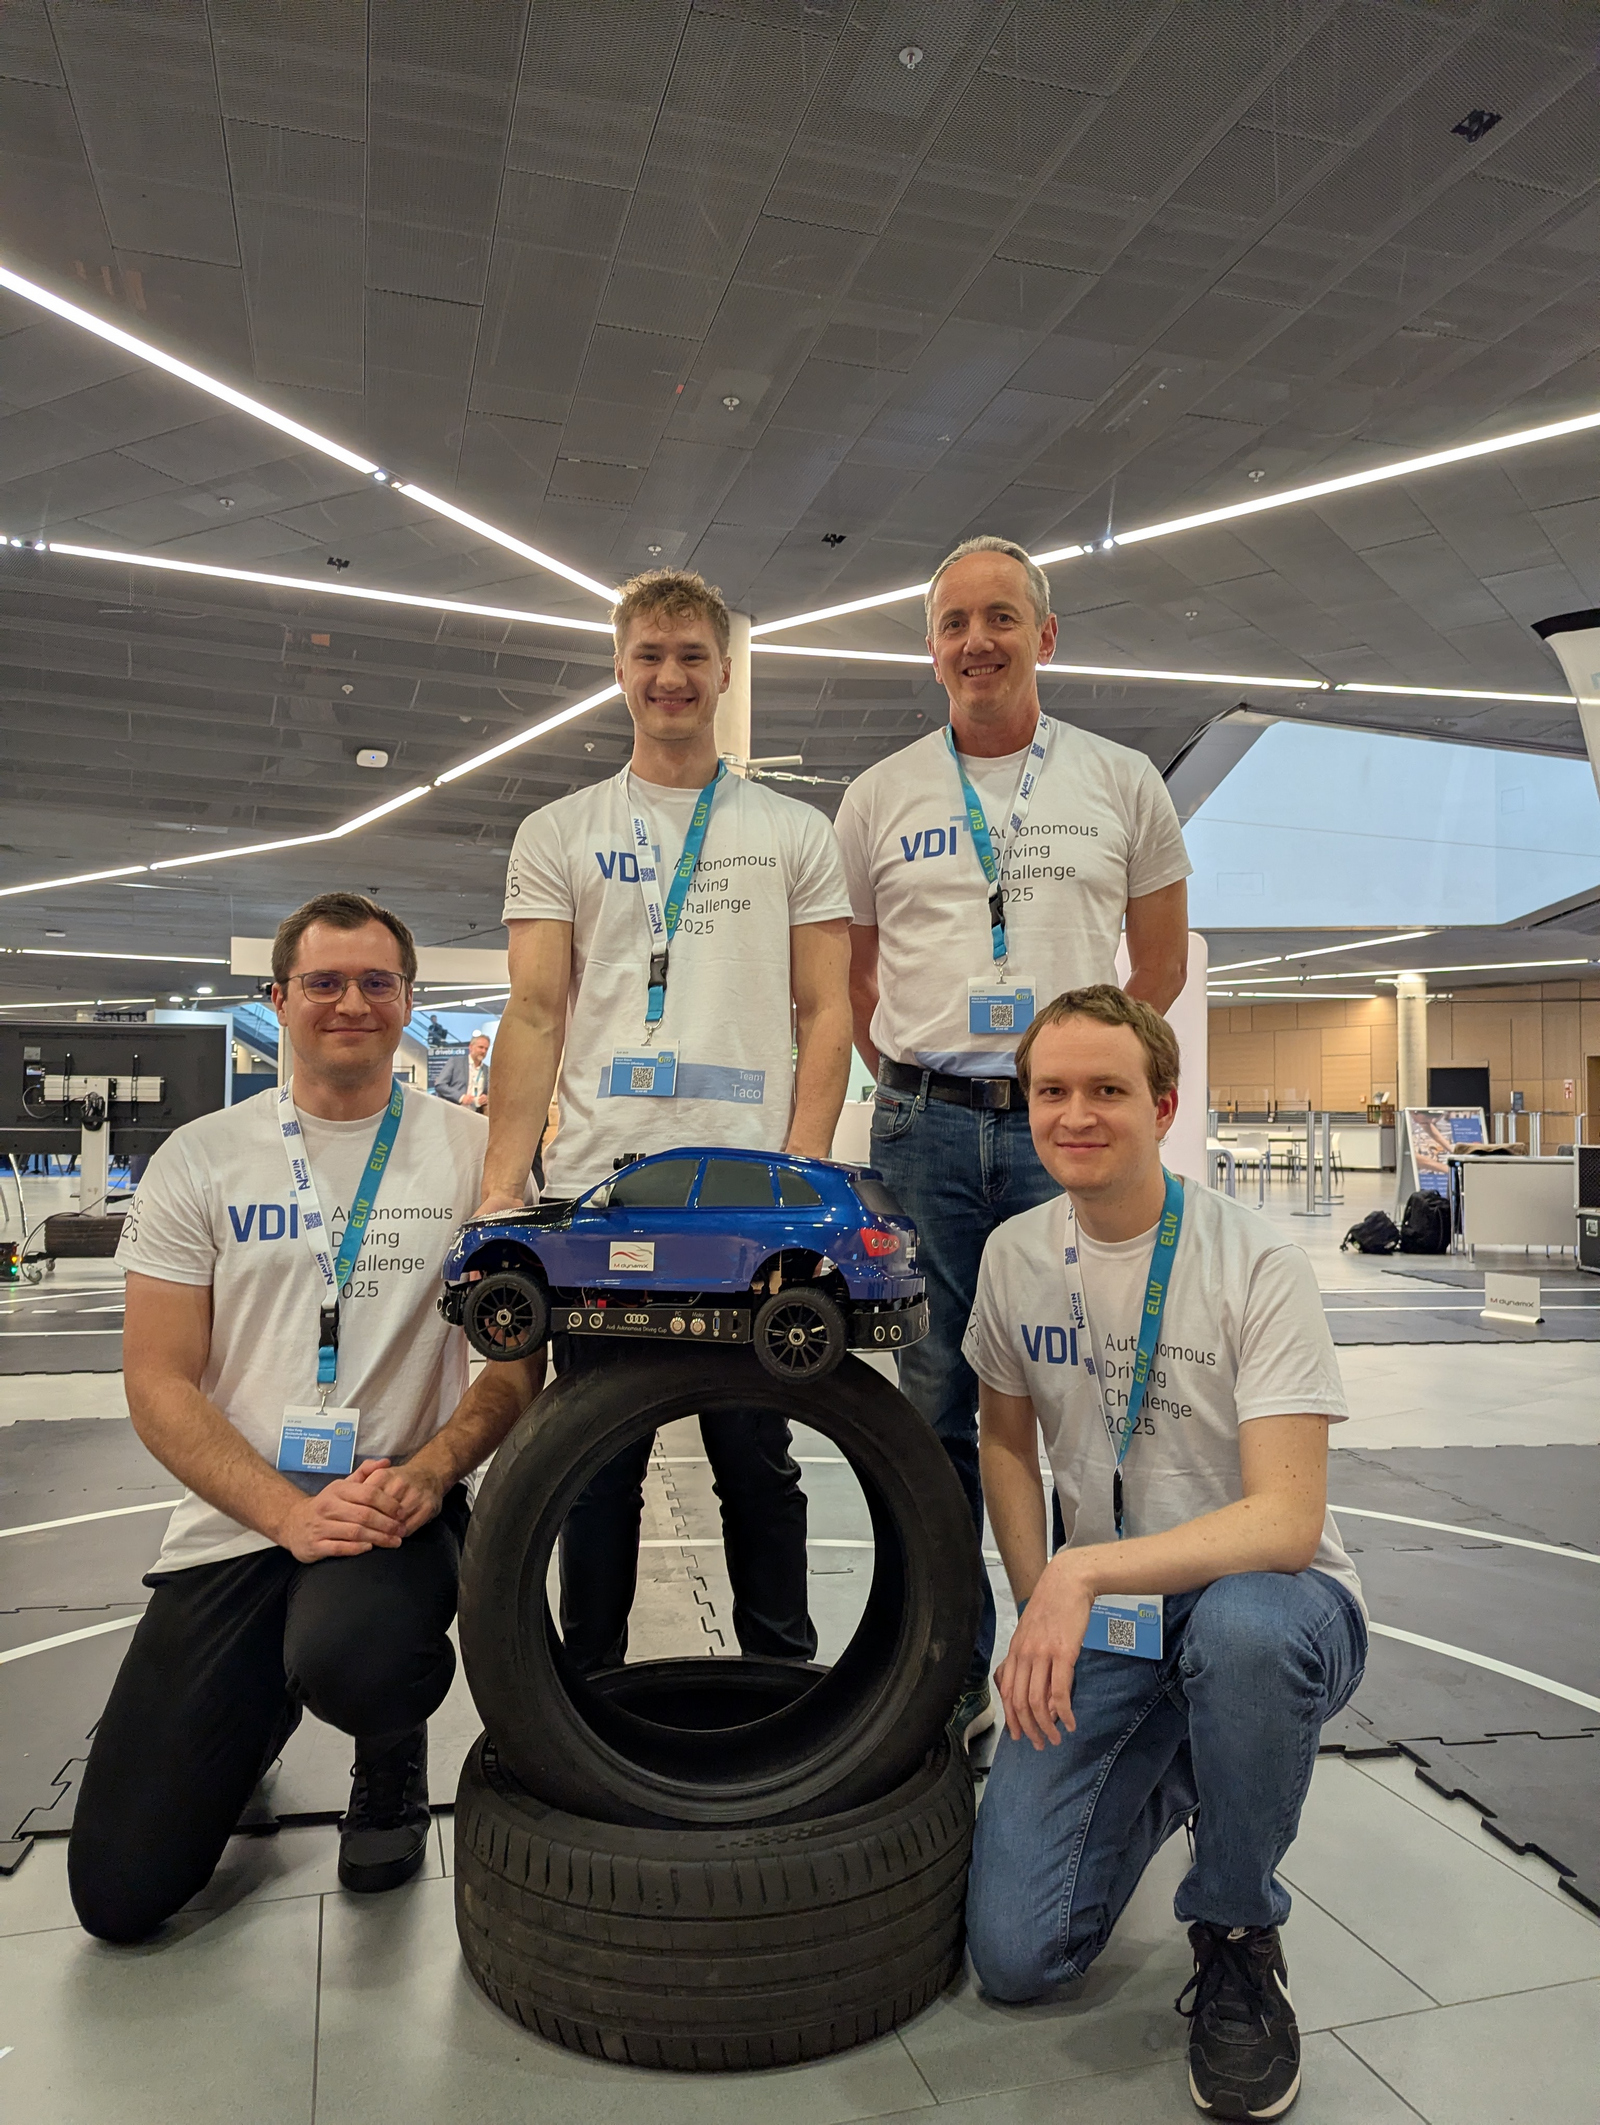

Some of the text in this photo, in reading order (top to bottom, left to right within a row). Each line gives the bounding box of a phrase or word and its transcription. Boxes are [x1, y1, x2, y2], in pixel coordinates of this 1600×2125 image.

[694, 803, 708, 826] ELIV
[970, 809, 984, 830] ELIV
[634, 818, 648, 846] NAVIN
[900, 826, 956, 862] VDI
[989, 825, 1098, 839] Auonomous
[595, 850, 640, 883] VD
[673, 855, 777, 872] tonomous
[680, 852, 695, 877] ELIV
[982, 855, 995, 880] ELIV
[999, 864, 1075, 881] hallenge
[688, 878, 728, 893] riving
[1002, 887, 1033, 903] 025
[648, 904, 663, 934] NAVIN
[666, 902, 679, 928] ELIV
[682, 898, 751, 914] hallenge
[676, 918, 714, 935] 2025
[739, 1071, 763, 1081] Team
[391, 1090, 404, 1117] ELIV
[732, 1084, 761, 1099] Taco
[370, 1142, 388, 1171] ELIV
[292, 1159, 310, 1190] NAVIN
[228, 1204, 298, 1242] VDI
[331, 1206, 453, 1221] Aonomous
[352, 1199, 369, 1228] ELIV
[331, 1230, 400, 1248] Dving
[1161, 1212, 1178, 1246] ELIV
[316, 1253, 334, 1285] NAVIN
[332, 1255, 424, 1273] allenge
[342, 1281, 378, 1299] 025
[1146, 1280, 1163, 1315] ELIV
[1071, 1293, 1085, 1329] NAVIN
[1021, 1324, 1078, 1366] VDI
[1105, 1333, 1216, 1366] Autnomous
[1105, 1360, 1166, 1388] Dring
[1135, 1348, 1148, 1383] ELIV
[1105, 1388, 1192, 1419] Chllenge
